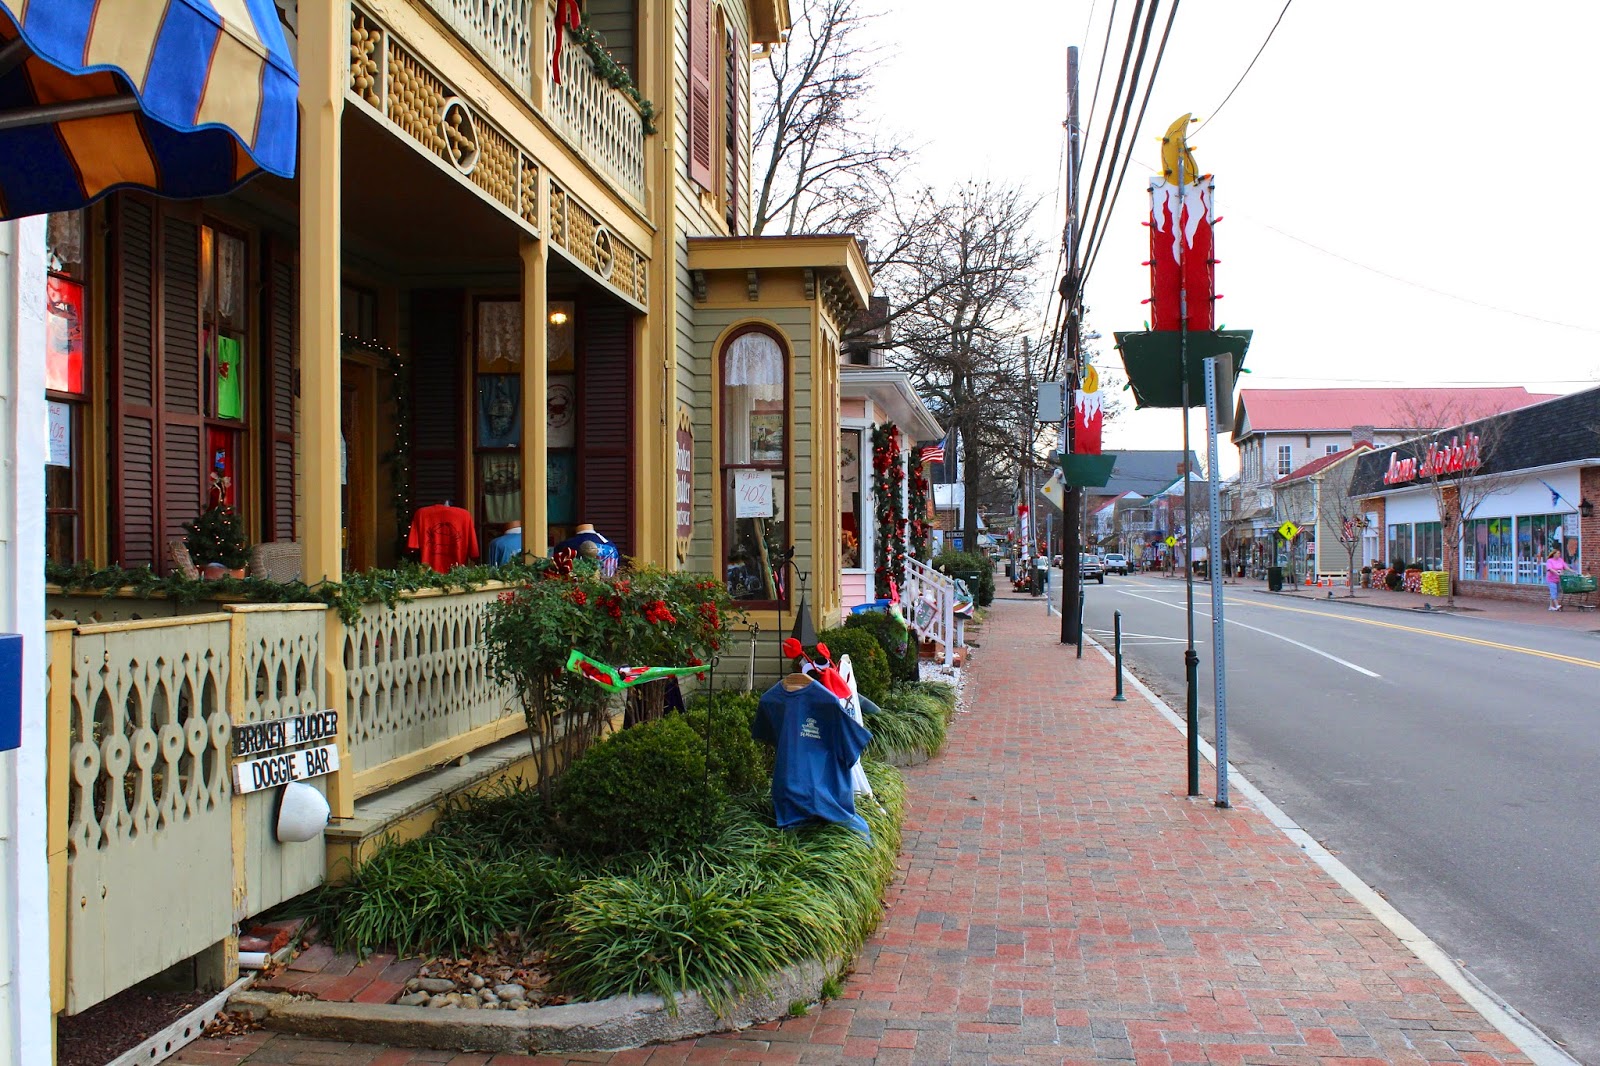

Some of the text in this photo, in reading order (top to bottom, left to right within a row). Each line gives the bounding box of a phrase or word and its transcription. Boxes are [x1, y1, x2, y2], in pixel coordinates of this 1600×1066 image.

[740, 483, 768, 504] 40%
[238, 710, 338, 755] BROKEN RUDDER
[306, 747, 330, 777] BAR
